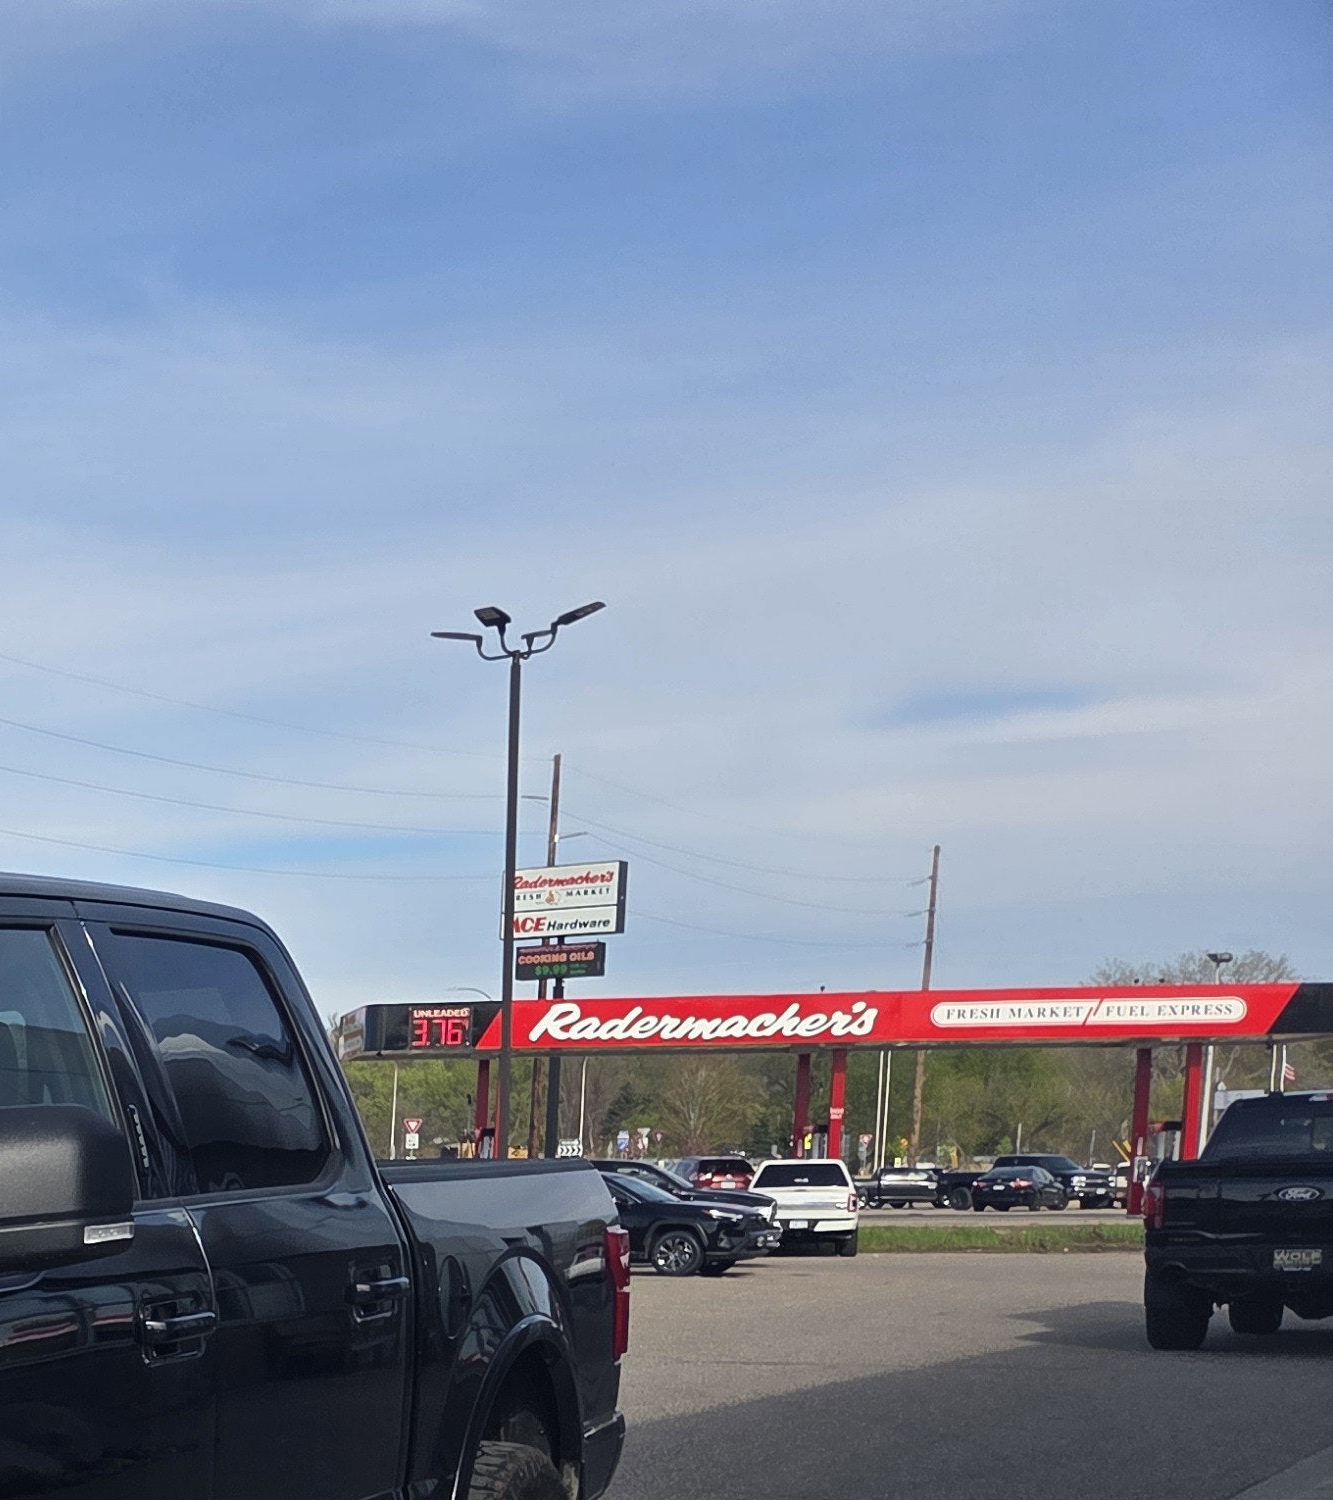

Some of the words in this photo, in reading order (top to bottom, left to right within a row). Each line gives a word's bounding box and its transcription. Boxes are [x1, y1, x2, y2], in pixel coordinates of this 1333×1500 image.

[514, 870, 614, 890] Radermacher's
[565, 887, 611, 897] MARKET
[546, 918, 611, 932] Hardware
[517, 952, 567, 965] COOKING
[569, 950, 595, 962] OILS
[534, 963, 568, 976] $9.99
[413, 1007, 470, 1018] UNLEADED
[946, 1008, 1001, 1020] FRESH
[1008, 1006, 1085, 1019] MARKET
[1106, 1004, 1149, 1017] FUEL
[1157, 1003, 1234, 1017] EXPRESS
[529, 1001, 878, 1042] Radermacher's
